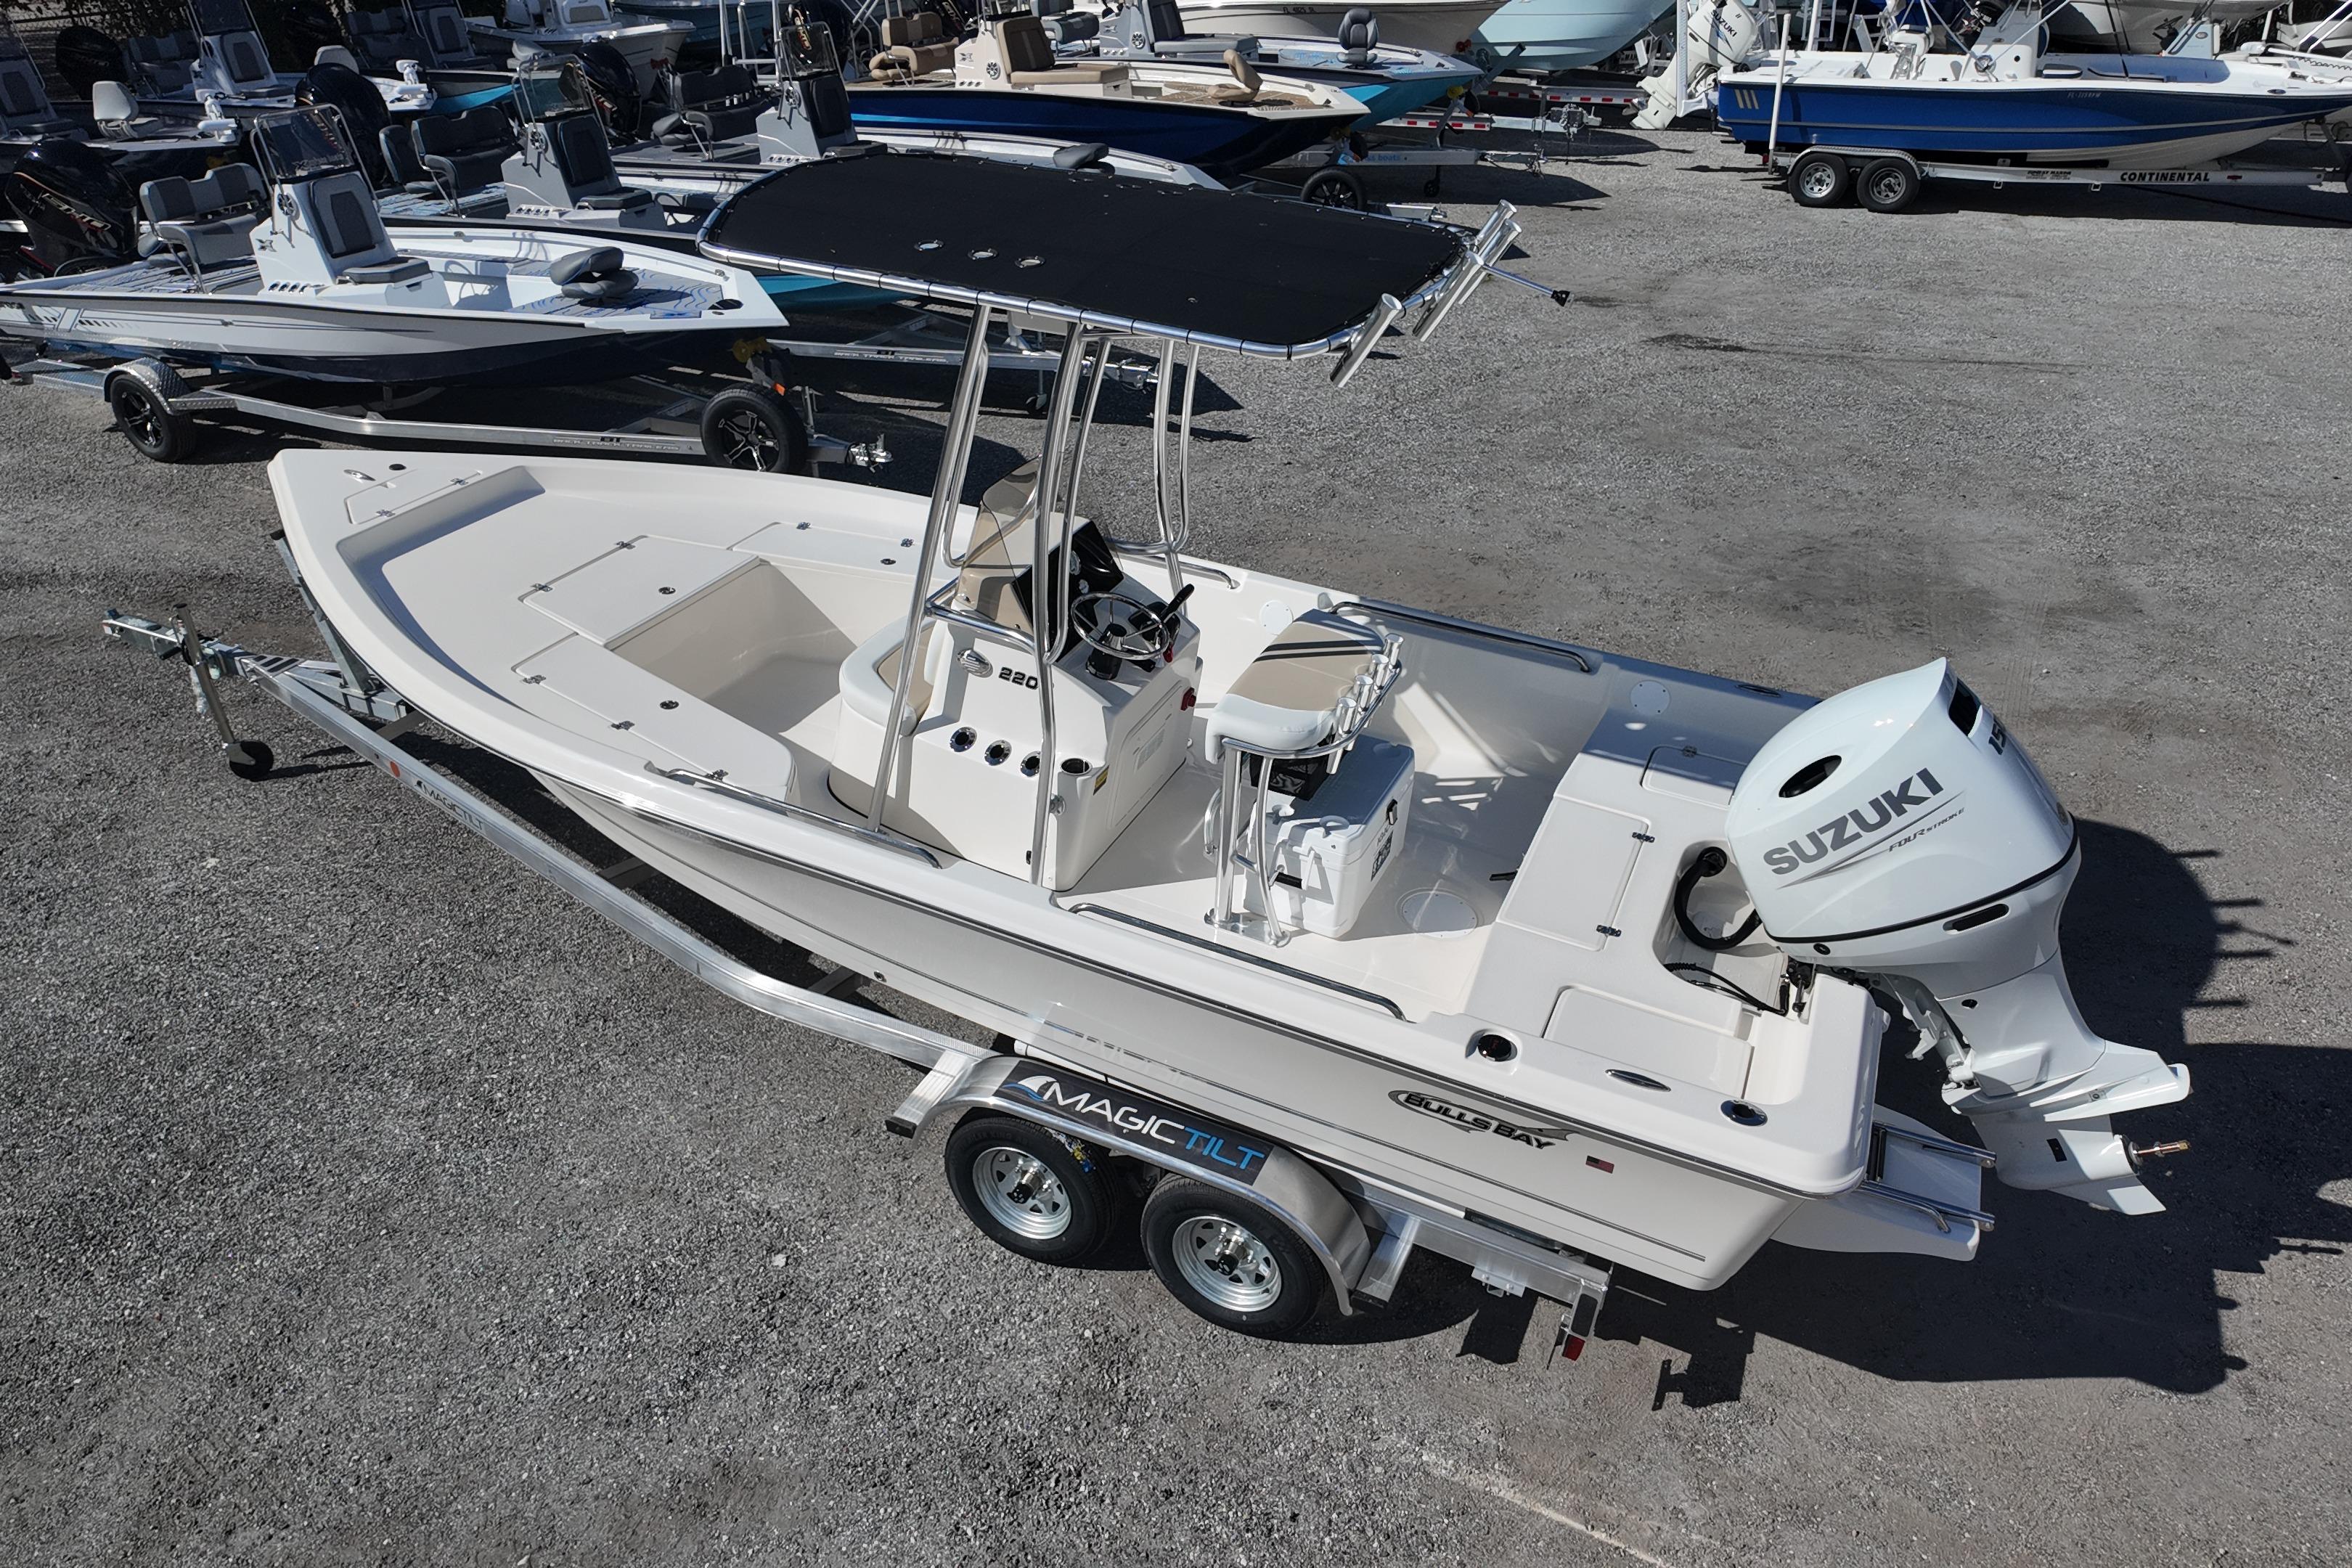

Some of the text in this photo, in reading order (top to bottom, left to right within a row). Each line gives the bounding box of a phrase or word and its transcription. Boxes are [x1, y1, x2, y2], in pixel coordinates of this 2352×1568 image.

[1711, 9, 1737, 37] SUZUKI
[2120, 172, 2210, 181] CONTINENTAL
[998, 666, 1040, 690] 220
[1763, 767, 1944, 875] SUZUKI
[1889, 807, 1965, 852] FOUR STROKE
[1403, 1092, 1556, 1150] BULLS BAY
